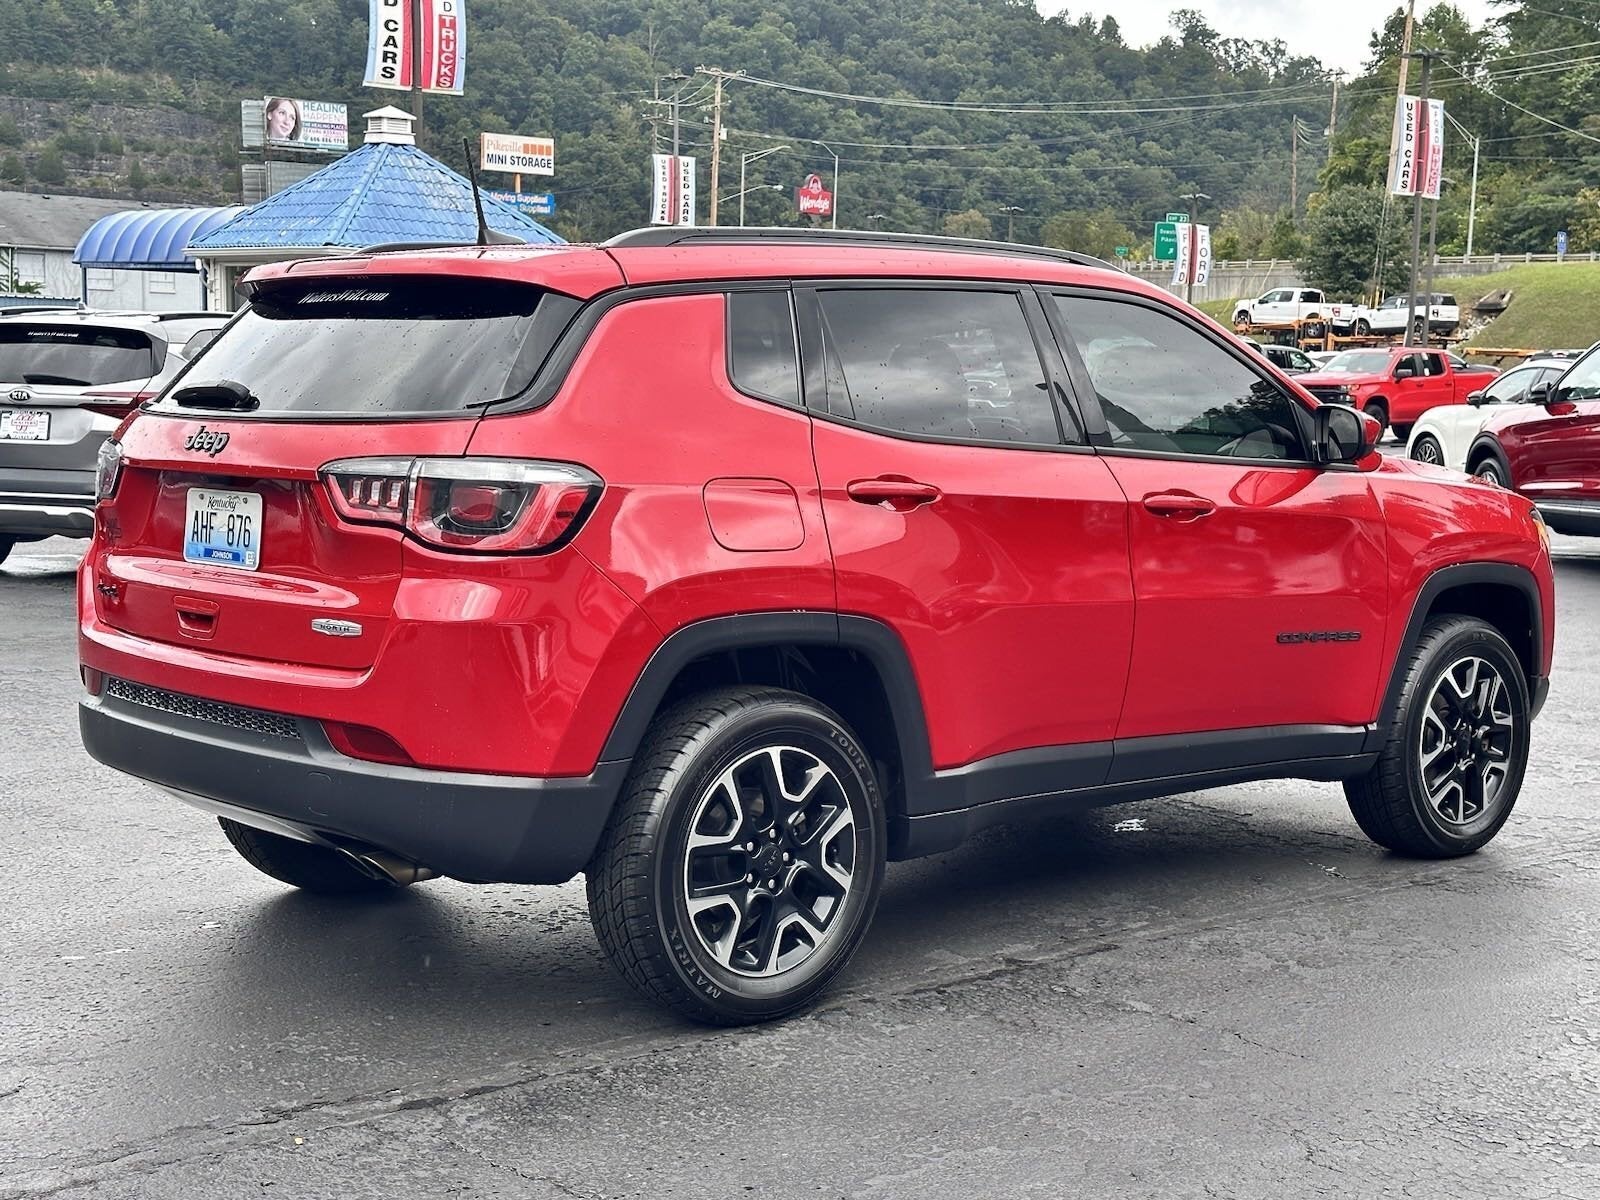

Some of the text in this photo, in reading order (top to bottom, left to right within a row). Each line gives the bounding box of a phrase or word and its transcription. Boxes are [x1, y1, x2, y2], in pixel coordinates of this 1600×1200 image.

[380, 19, 399, 79] CARS
[439, 16, 455, 88] TRUCKS
[303, 101, 346, 114] HEALING
[486, 139, 522, 153] Pikeville
[1401, 102, 1413, 190] USED CARS
[486, 153, 552, 169] MINI STORAGE
[490, 191, 516, 203] Moving
[800, 195, 830, 213] Wendy's
[1198, 235, 1208, 283] FORD
[11, 391, 29, 401] KIA
[184, 425, 230, 458] Jeep
[207, 496, 238, 512] Kentucky
[191, 510, 252, 548] AHF 876
[212, 550, 233, 560] JOHNSON
[320, 624, 350, 632] NORTH
[1276, 631, 1362, 643] COMPASS
[830, 727, 866, 770] TOUR
[669, 924, 722, 999] MATRIX
